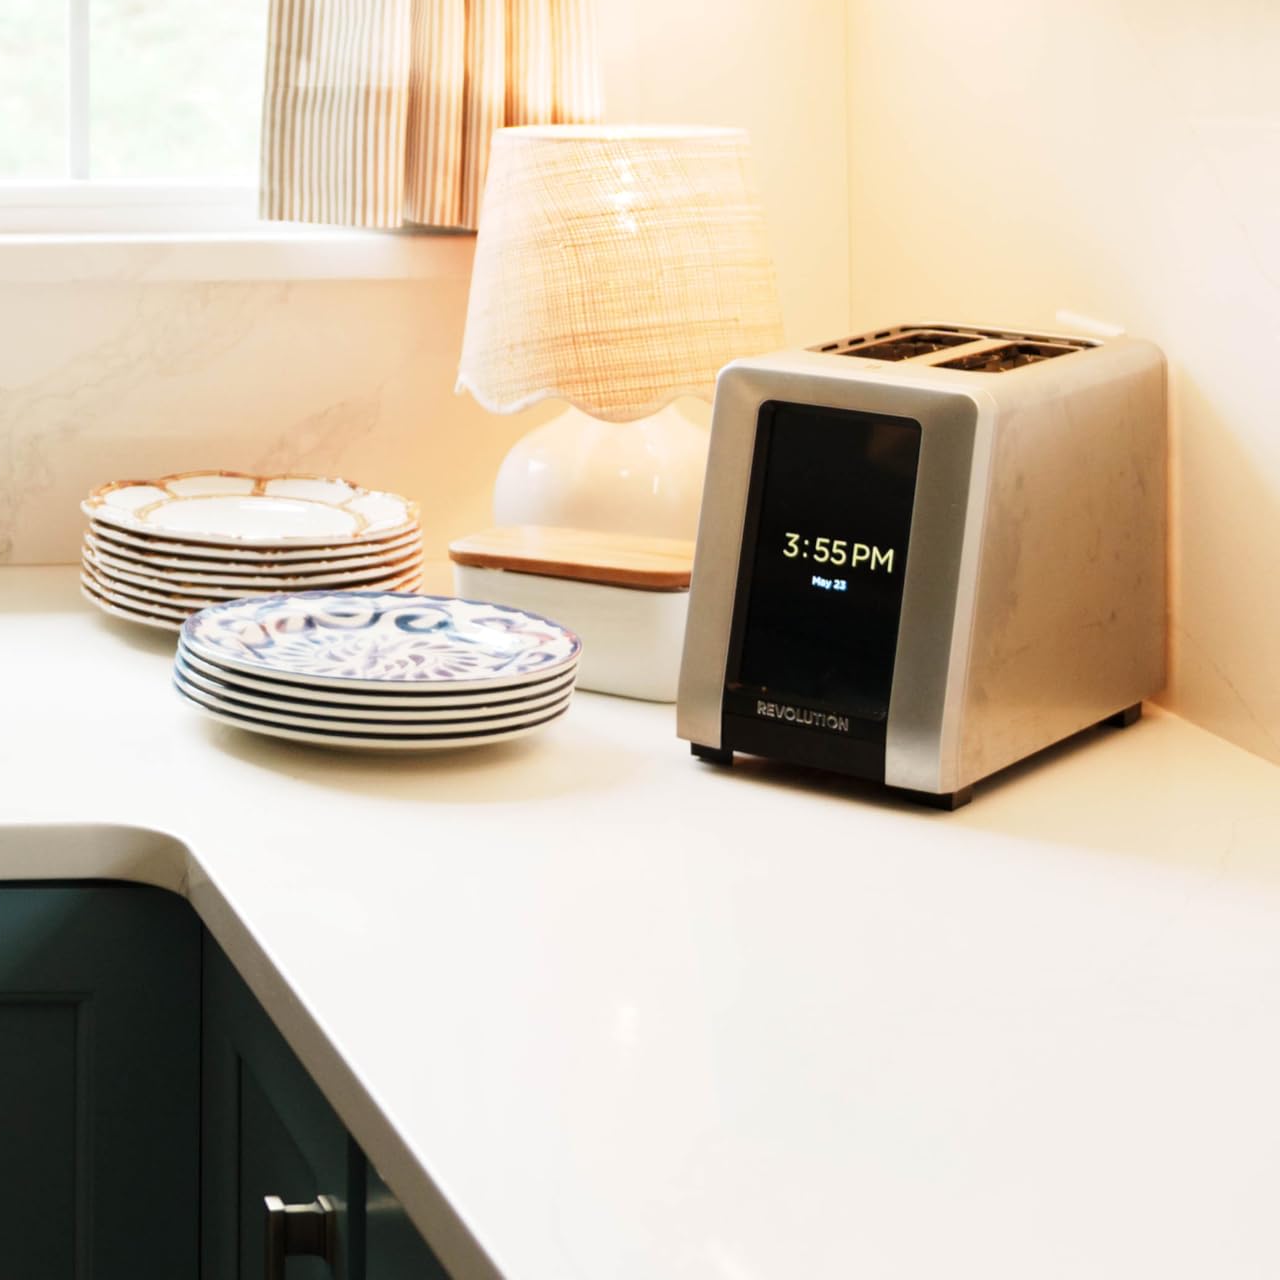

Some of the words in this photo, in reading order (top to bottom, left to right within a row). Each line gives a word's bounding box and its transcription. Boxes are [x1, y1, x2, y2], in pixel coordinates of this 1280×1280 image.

[783, 532, 848, 566] 3:55
[851, 543, 895, 573] PM
[812, 576, 832, 589] May
[833, 580, 847, 591] 23
[757, 700, 849, 732] REVOLUTION
